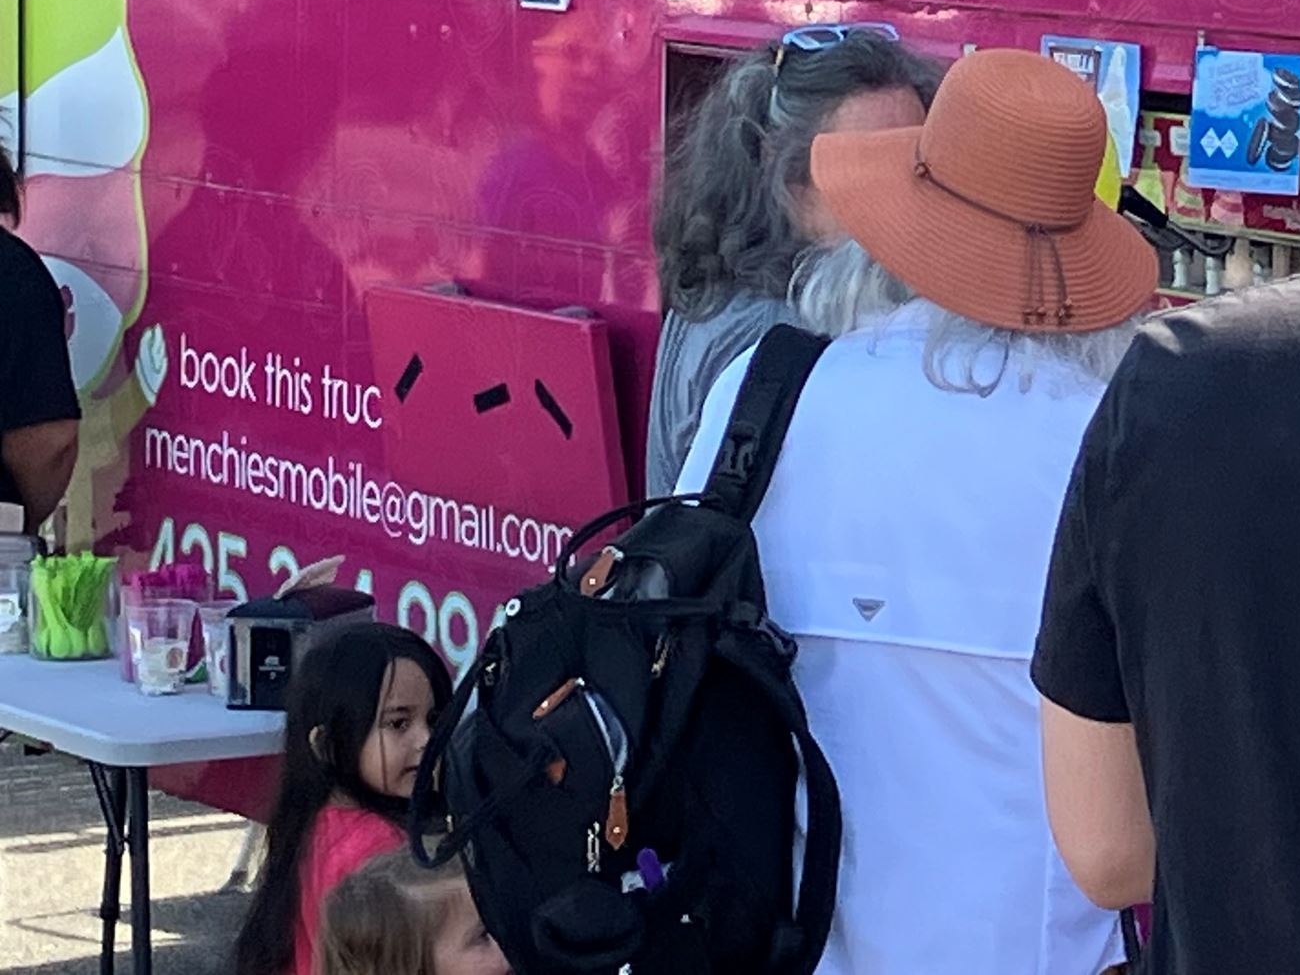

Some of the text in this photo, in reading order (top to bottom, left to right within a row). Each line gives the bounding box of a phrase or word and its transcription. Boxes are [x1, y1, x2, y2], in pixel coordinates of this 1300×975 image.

[180, 333, 383, 428] book this truc
[145, 425, 576, 568] menchiesmobile@gmail.com
